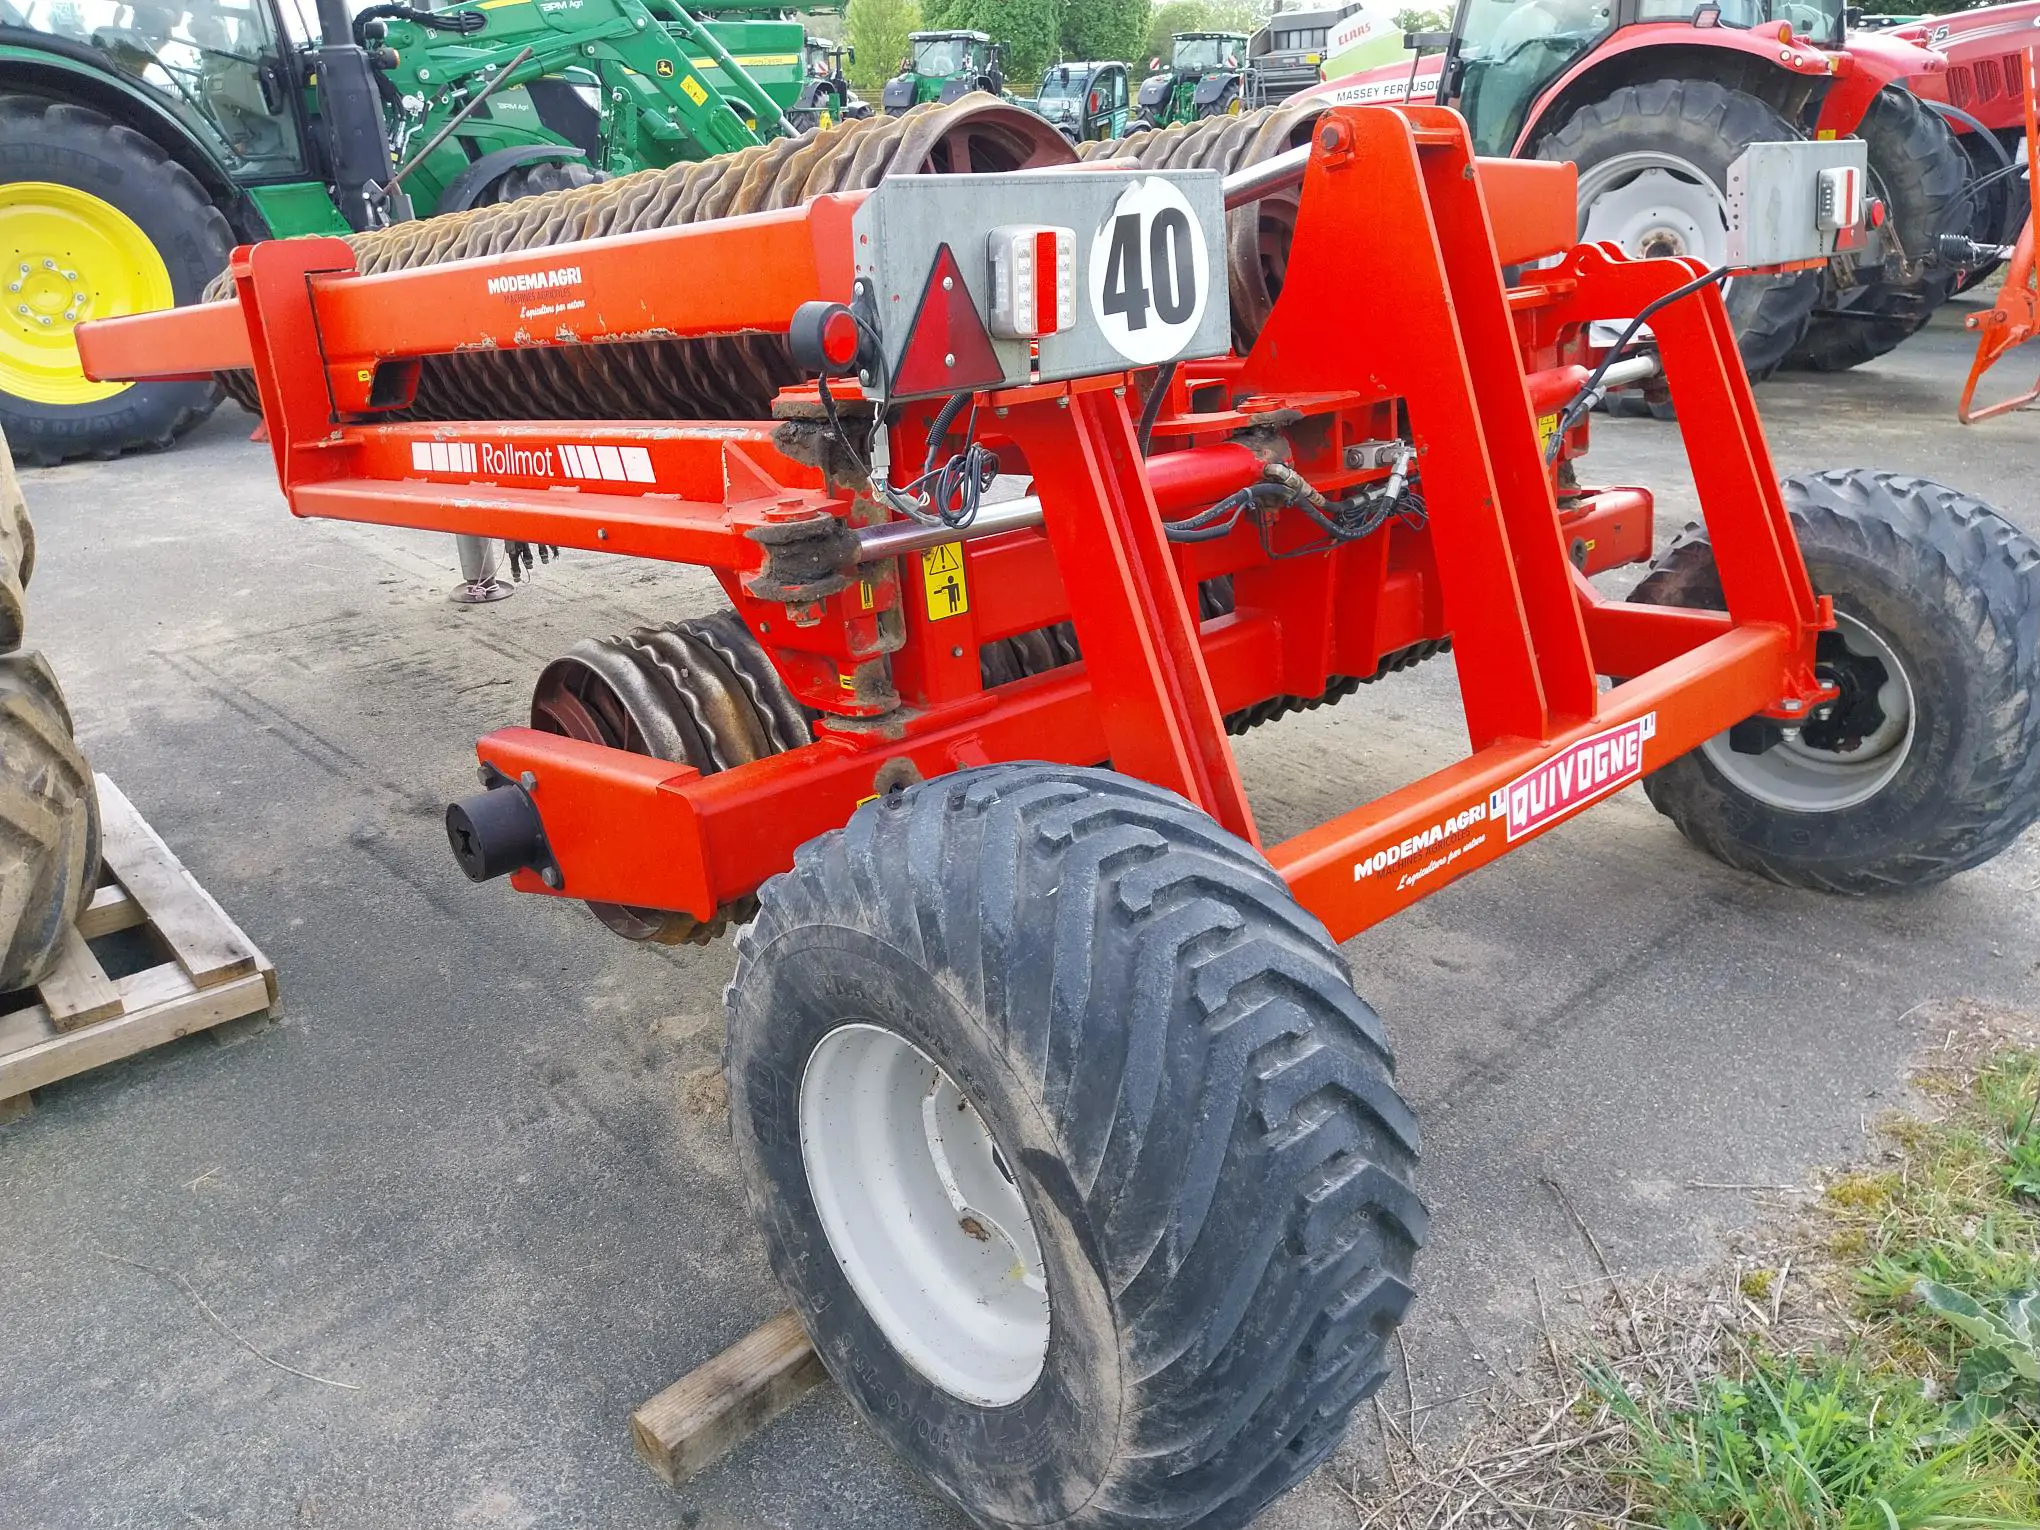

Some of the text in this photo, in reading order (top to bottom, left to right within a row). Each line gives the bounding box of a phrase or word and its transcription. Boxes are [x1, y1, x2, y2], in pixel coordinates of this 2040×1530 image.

[1338, 23, 1371, 46] CLAAS
[1337, 87, 1380, 102] MASSEY
[1103, 207, 1196, 332] 40
[481, 443, 554, 477] Rollmot
[1511, 730, 1639, 828] QUIVOGNE
[1377, 828, 1471, 880] MACHINES AGRICOLES
